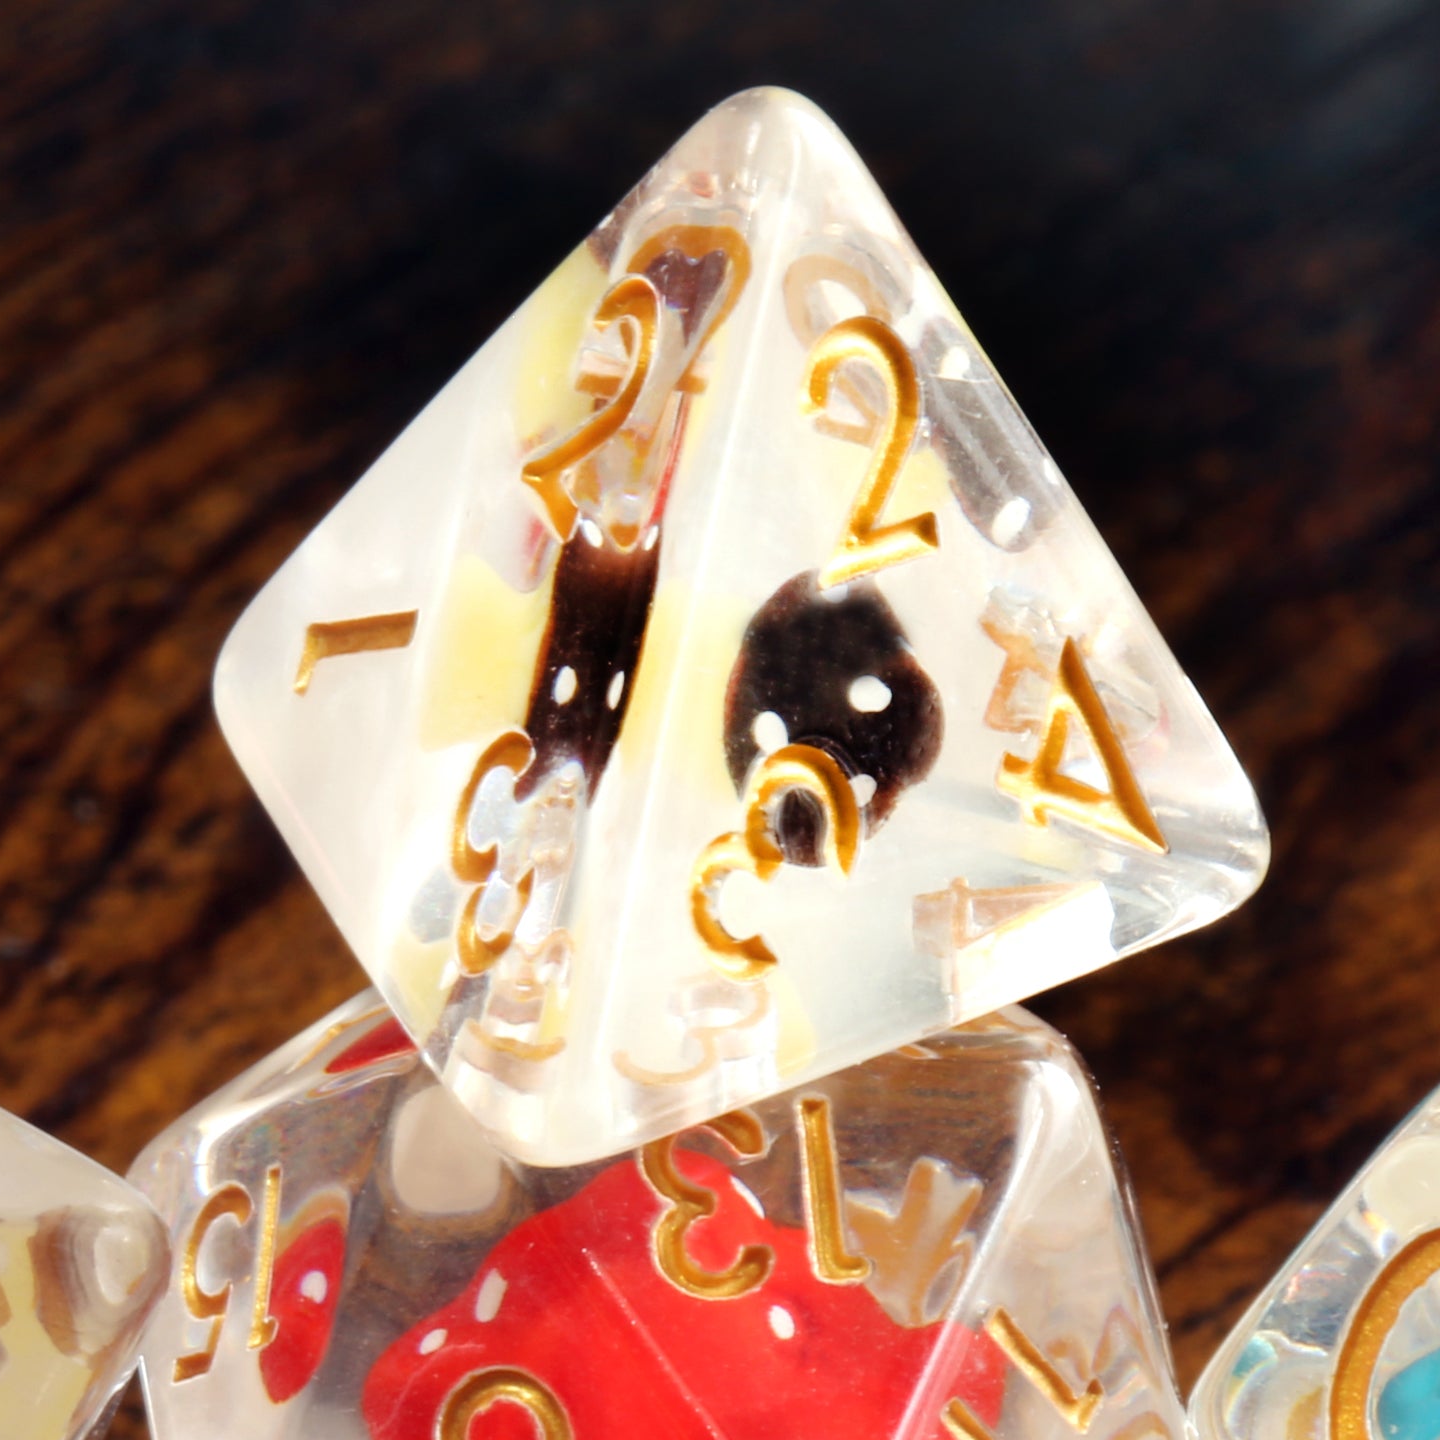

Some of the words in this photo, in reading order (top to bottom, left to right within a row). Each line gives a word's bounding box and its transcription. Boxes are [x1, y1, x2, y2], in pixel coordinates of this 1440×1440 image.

[801, 314, 941, 591] 2
[994, 635, 1171, 857] 4
[687, 741, 861, 984] 3
[170, 1162, 283, 1386] 15
[636, 1095, 872, 1302] 13
